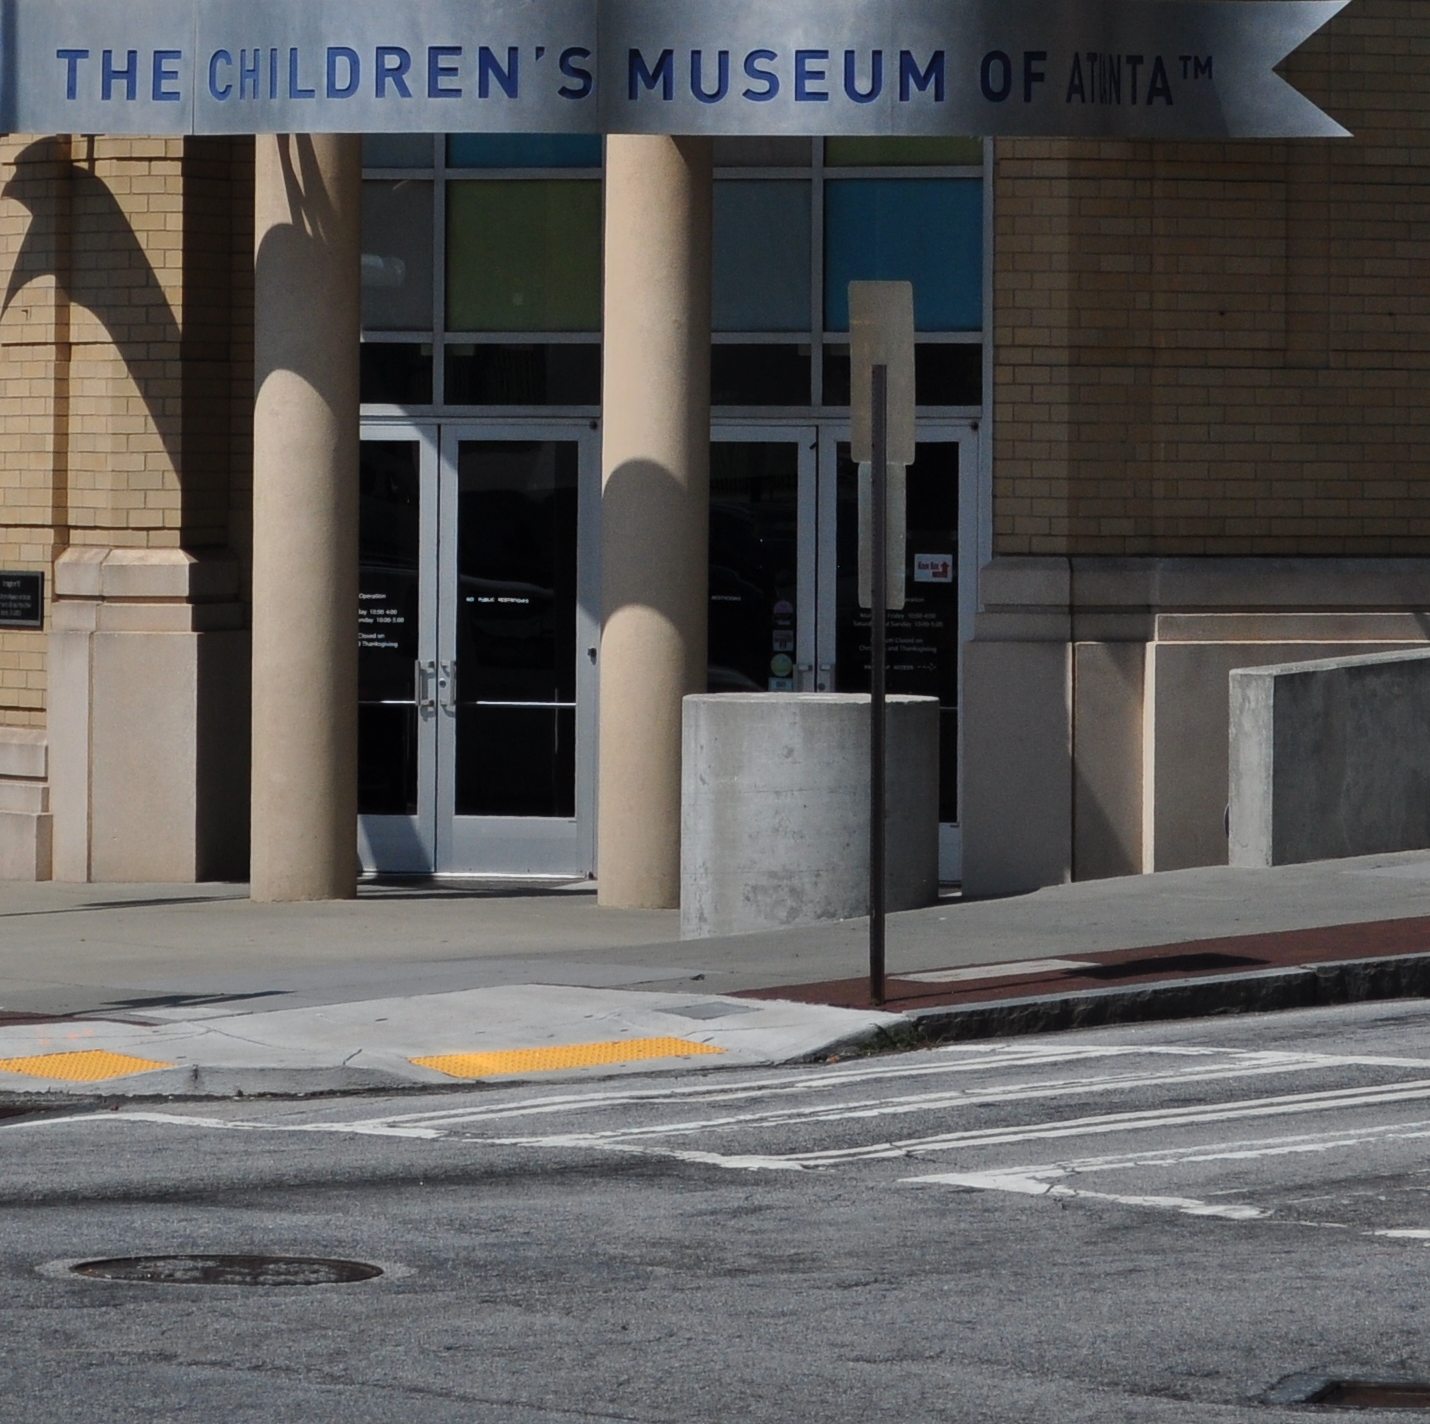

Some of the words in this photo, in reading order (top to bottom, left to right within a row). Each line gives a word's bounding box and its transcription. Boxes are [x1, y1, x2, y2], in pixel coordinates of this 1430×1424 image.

[55, 48, 182, 102] THE
[206, 45, 593, 101] CHILDREN'S
[626, 48, 947, 105] MUSEUM
[978, 50, 1048, 104] OF
